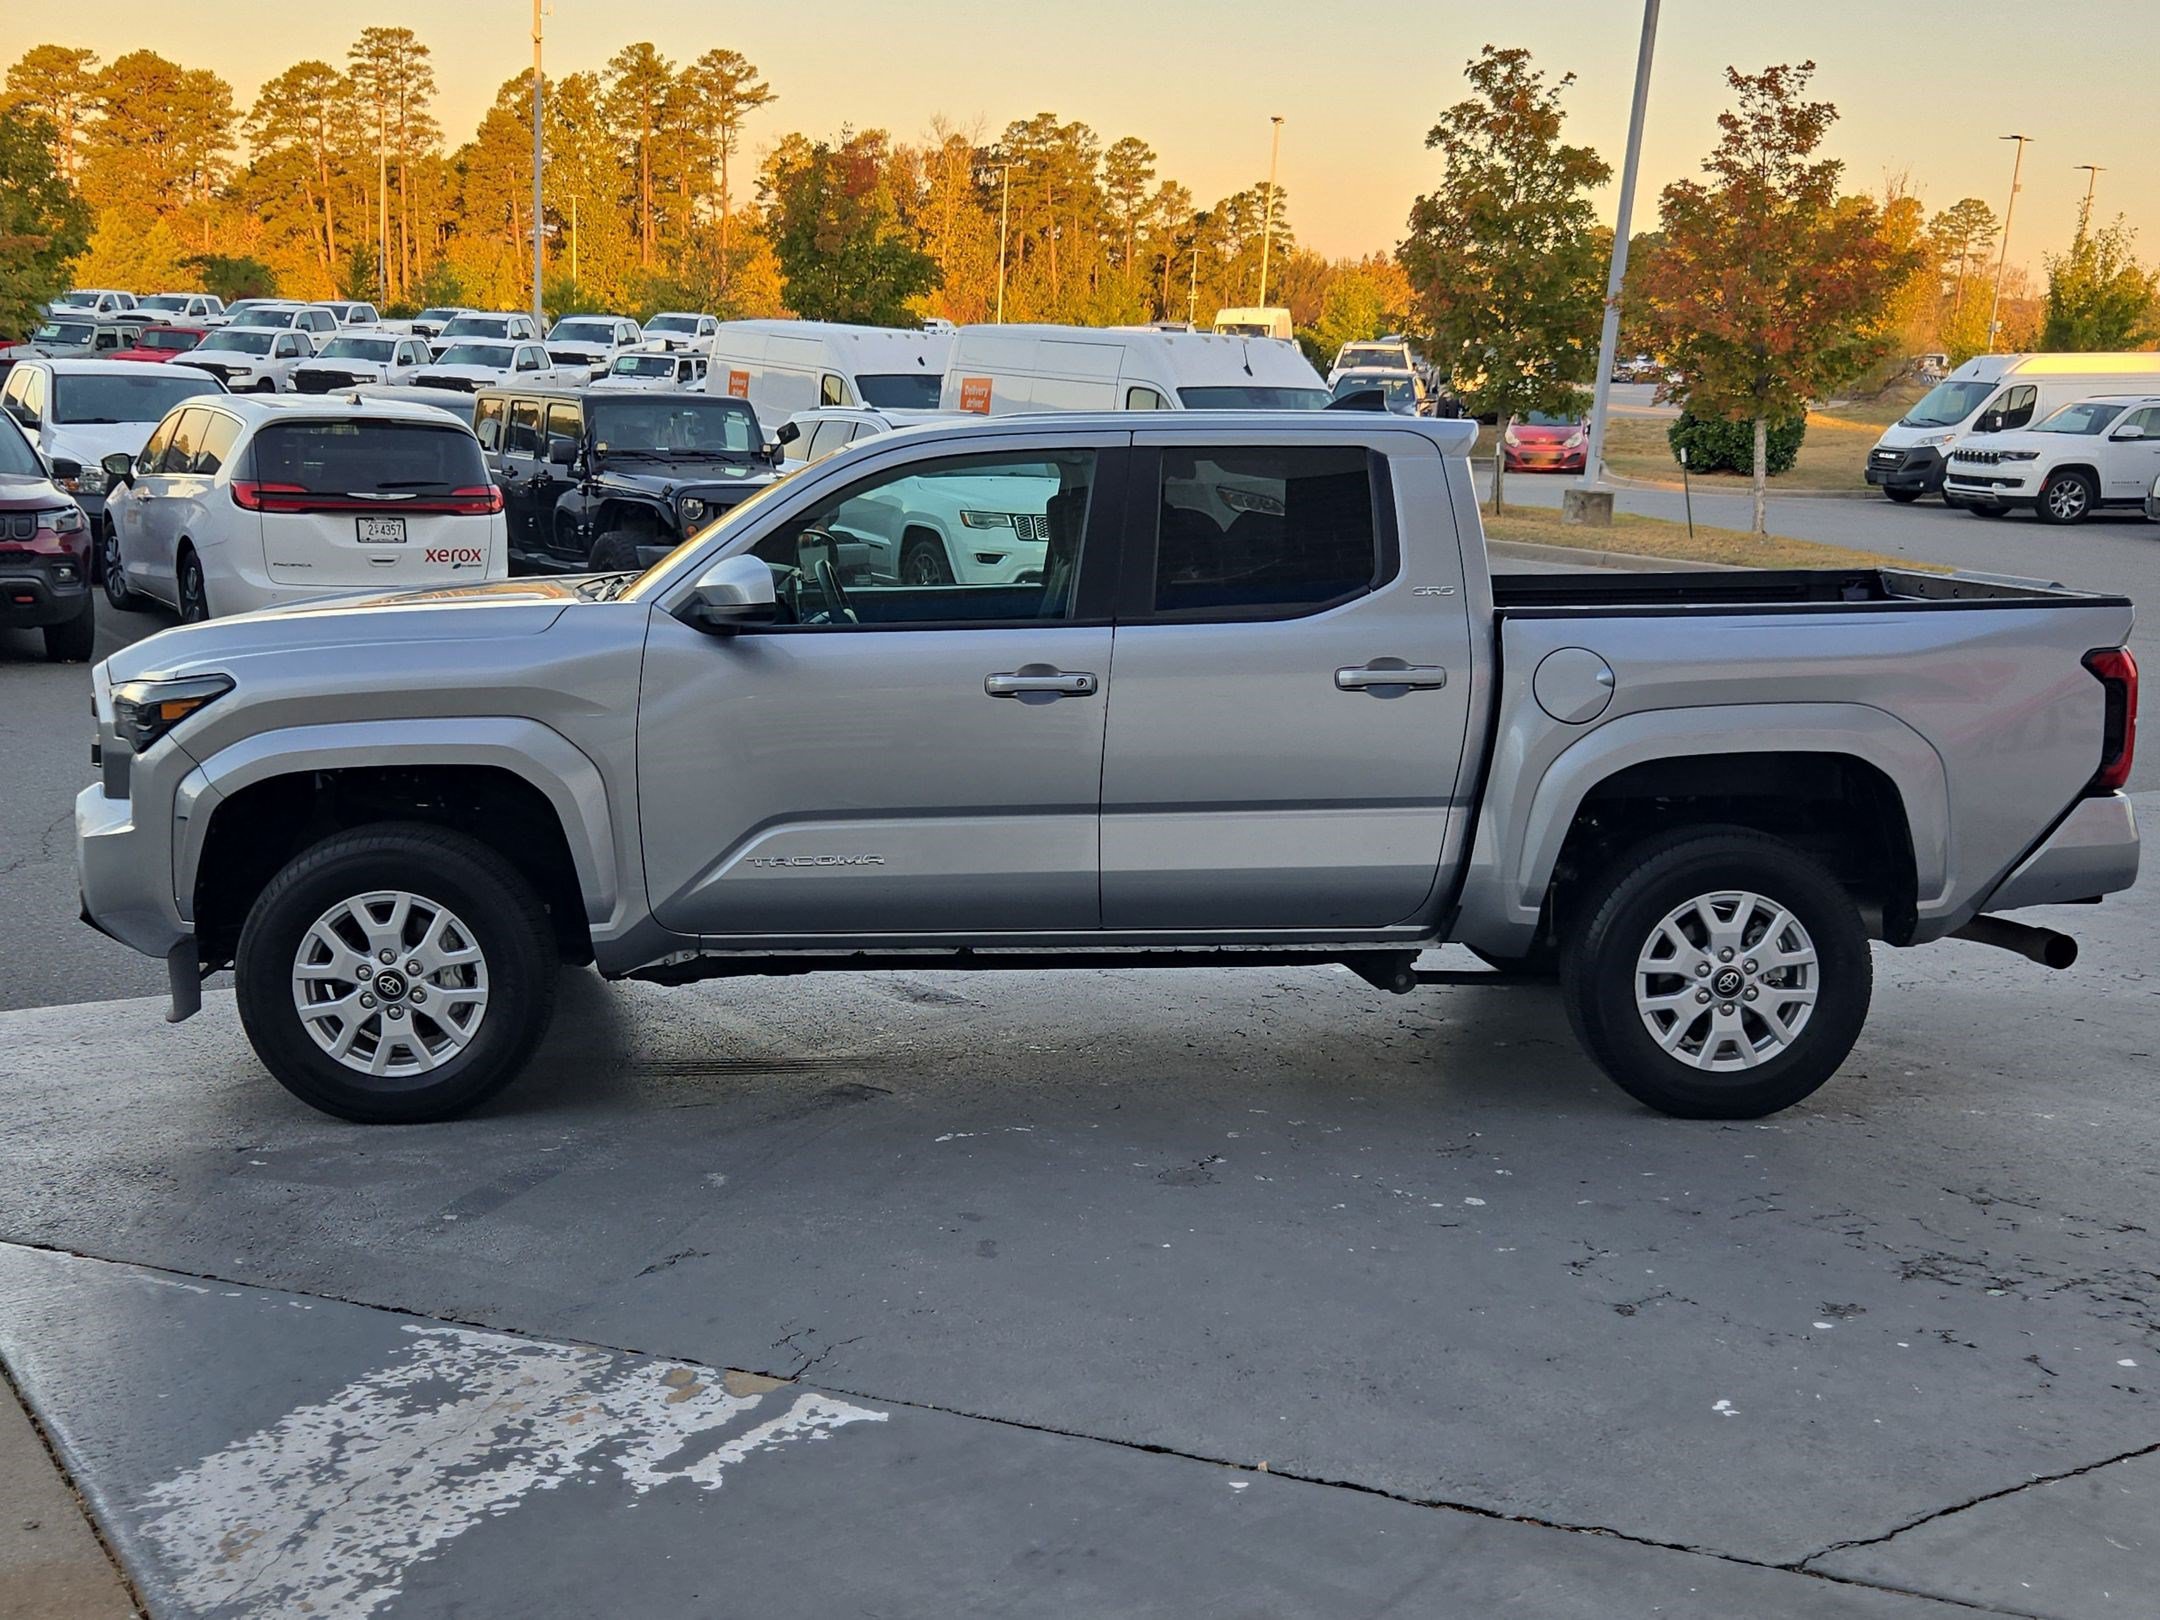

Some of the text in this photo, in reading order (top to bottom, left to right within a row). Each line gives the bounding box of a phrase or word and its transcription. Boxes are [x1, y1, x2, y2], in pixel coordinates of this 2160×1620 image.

[965, 385, 989, 398] Delivery
[966, 398, 985, 408] driver
[425, 549, 481, 562] xerox
[1412, 586, 1455, 597] SR5
[746, 854, 885, 867] TACOMA
